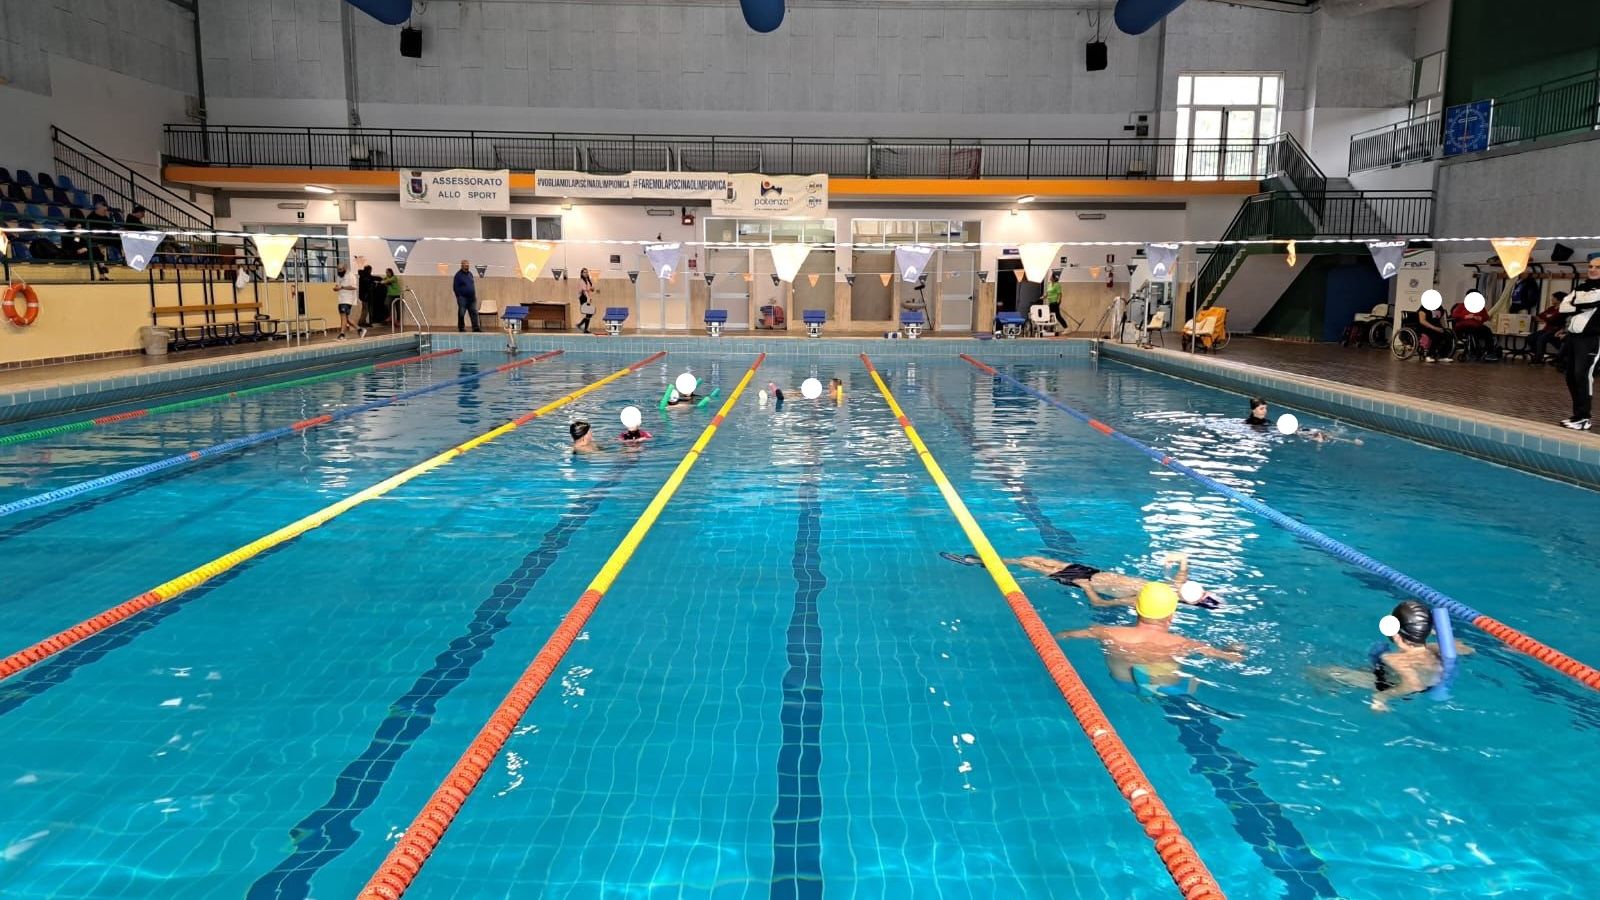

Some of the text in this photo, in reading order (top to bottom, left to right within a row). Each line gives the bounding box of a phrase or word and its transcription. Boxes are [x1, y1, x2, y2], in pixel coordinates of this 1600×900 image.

[432, 176, 503, 187] ASSESSORATO
[633, 179, 726, 190] #FAREMOLAPISCINAOLIMPIONICA
[438, 190, 497, 199] ALLO SPORT
[754, 198, 789, 206] potenza
[122, 232, 158, 242] HEAD
[1369, 240, 1406, 249] HEAD
